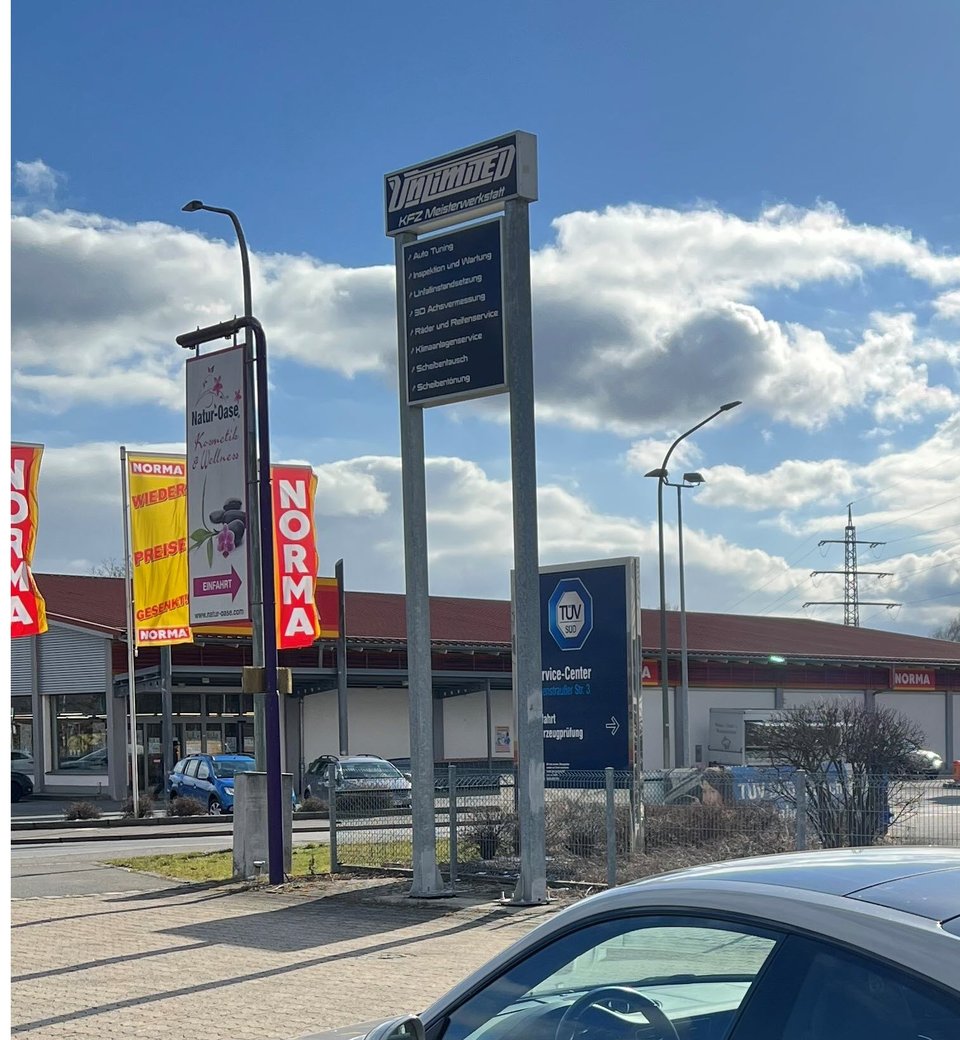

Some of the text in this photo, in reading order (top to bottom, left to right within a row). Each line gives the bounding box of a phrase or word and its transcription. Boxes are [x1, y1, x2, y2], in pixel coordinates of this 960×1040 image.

[398, 186, 506, 227] KFZ Meisterwerkstatt
[412, 243, 454, 260] Auto Tuning
[413, 252, 492, 280] Inspektion und Wartung
[413, 274, 483, 298] Unfallinstandsetzung
[414, 293, 486, 317] 3D Achsvermessung
[414, 310, 499, 335] Räder und Reifenservice
[415, 332, 483, 354] Klimaanlagenservice
[416, 354, 469, 373] Scheibentausch
[191, 404, 239, 426] Natur-Oase
[194, 426, 238, 451] Kosmetik
[132, 462, 183, 475] NORMA
[134, 537, 186, 567] PREISE
[279, 479, 315, 638] NORMA
[202, 579, 233, 592] EINFAHRT
[194, 609, 245, 619] www.natur-oase.com
[559, 604, 582, 620] TÜV
[140, 628, 189, 640] NORMA
[565, 624, 577, 634] SÜD
[542, 666, 592, 681] rvice-Center
[895, 672, 931, 685] NORMA
[543, 727, 583, 740] rzeugprüfung
